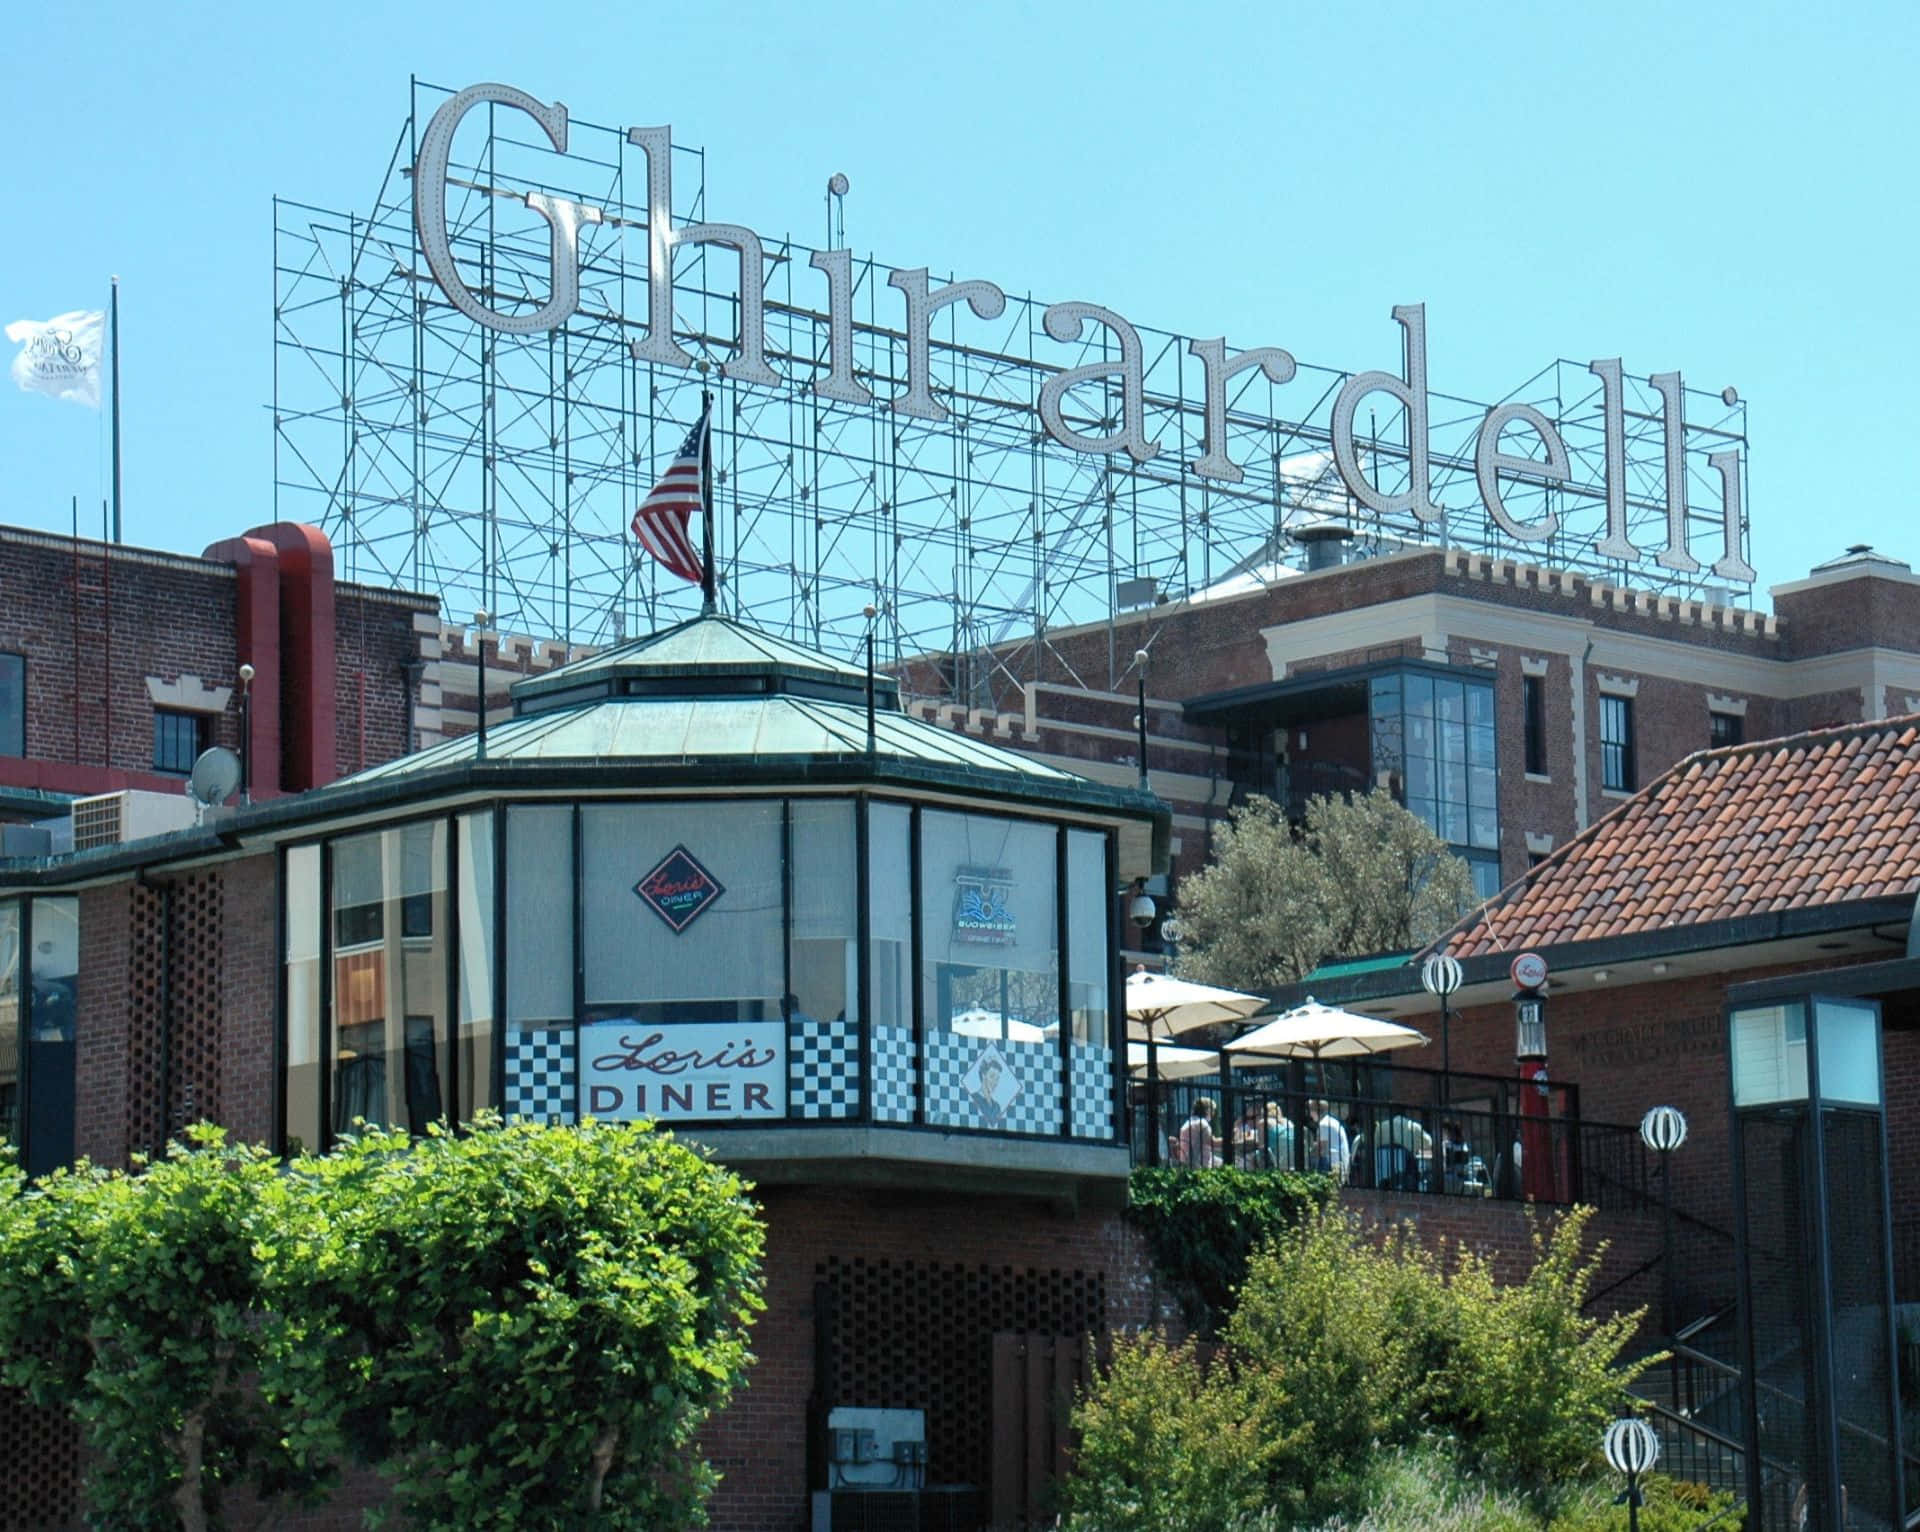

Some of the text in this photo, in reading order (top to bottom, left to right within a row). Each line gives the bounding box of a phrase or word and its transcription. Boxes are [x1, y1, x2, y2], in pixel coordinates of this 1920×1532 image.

[415, 82, 1757, 582] Ghirardelli
[661, 891, 703, 906] DINER
[592, 1032, 776, 1075] Lori's
[590, 1082, 774, 1113] DINER
